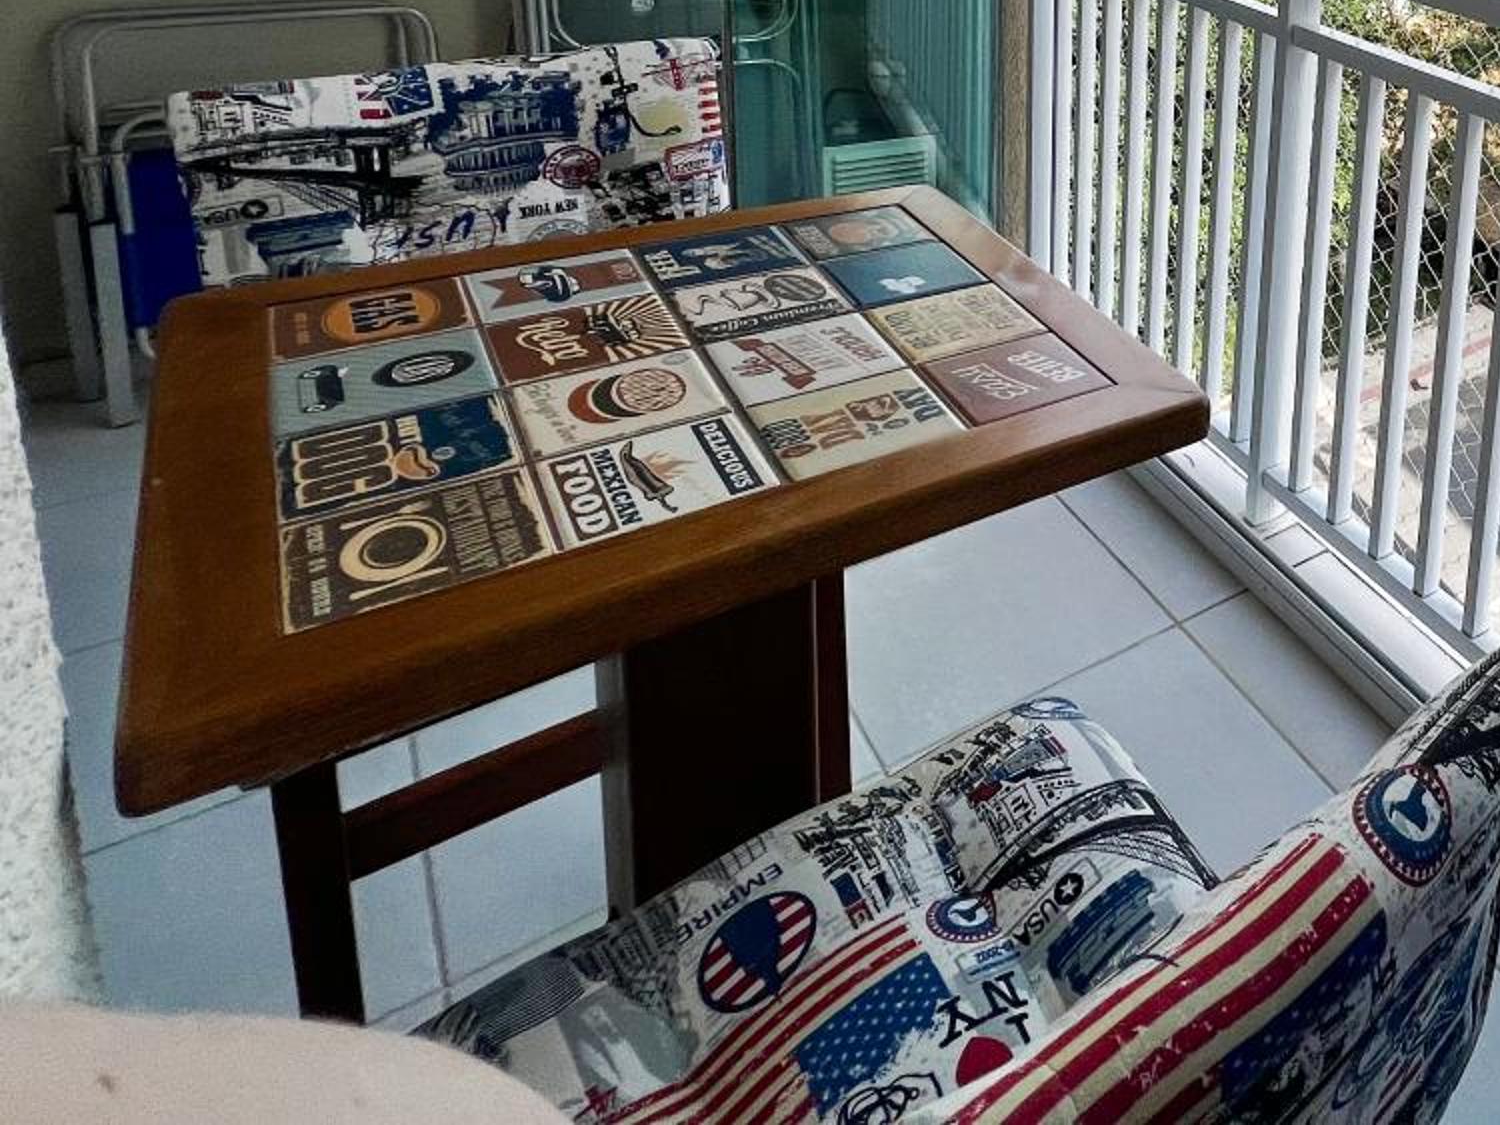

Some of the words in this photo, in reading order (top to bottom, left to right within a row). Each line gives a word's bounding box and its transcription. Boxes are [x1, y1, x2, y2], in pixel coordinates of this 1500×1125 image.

[518, 203, 550, 220] YORK
[554, 197, 580, 215] NEW
[349, 292, 420, 334] GAS
[714, 314, 760, 334] Coffee
[760, 300, 836, 323] Premium
[515, 315, 591, 366] Retro
[892, 385, 946, 424] DAY
[801, 408, 866, 451] DAY
[291, 420, 399, 510] DOG
[699, 421, 755, 489] DELICIOUS
[555, 460, 612, 535] FOOD
[589, 447, 644, 527] MEXICAN
[305, 524, 325, 553] OPEN
[440, 483, 500, 575] RESTAURANT
[309, 576, 332, 617] HOURS
[674, 862, 784, 943] EMPIRE
[1012, 899, 1057, 946] USA
[936, 971, 1029, 1049] NY
[1004, 1012, 1031, 1044] I
